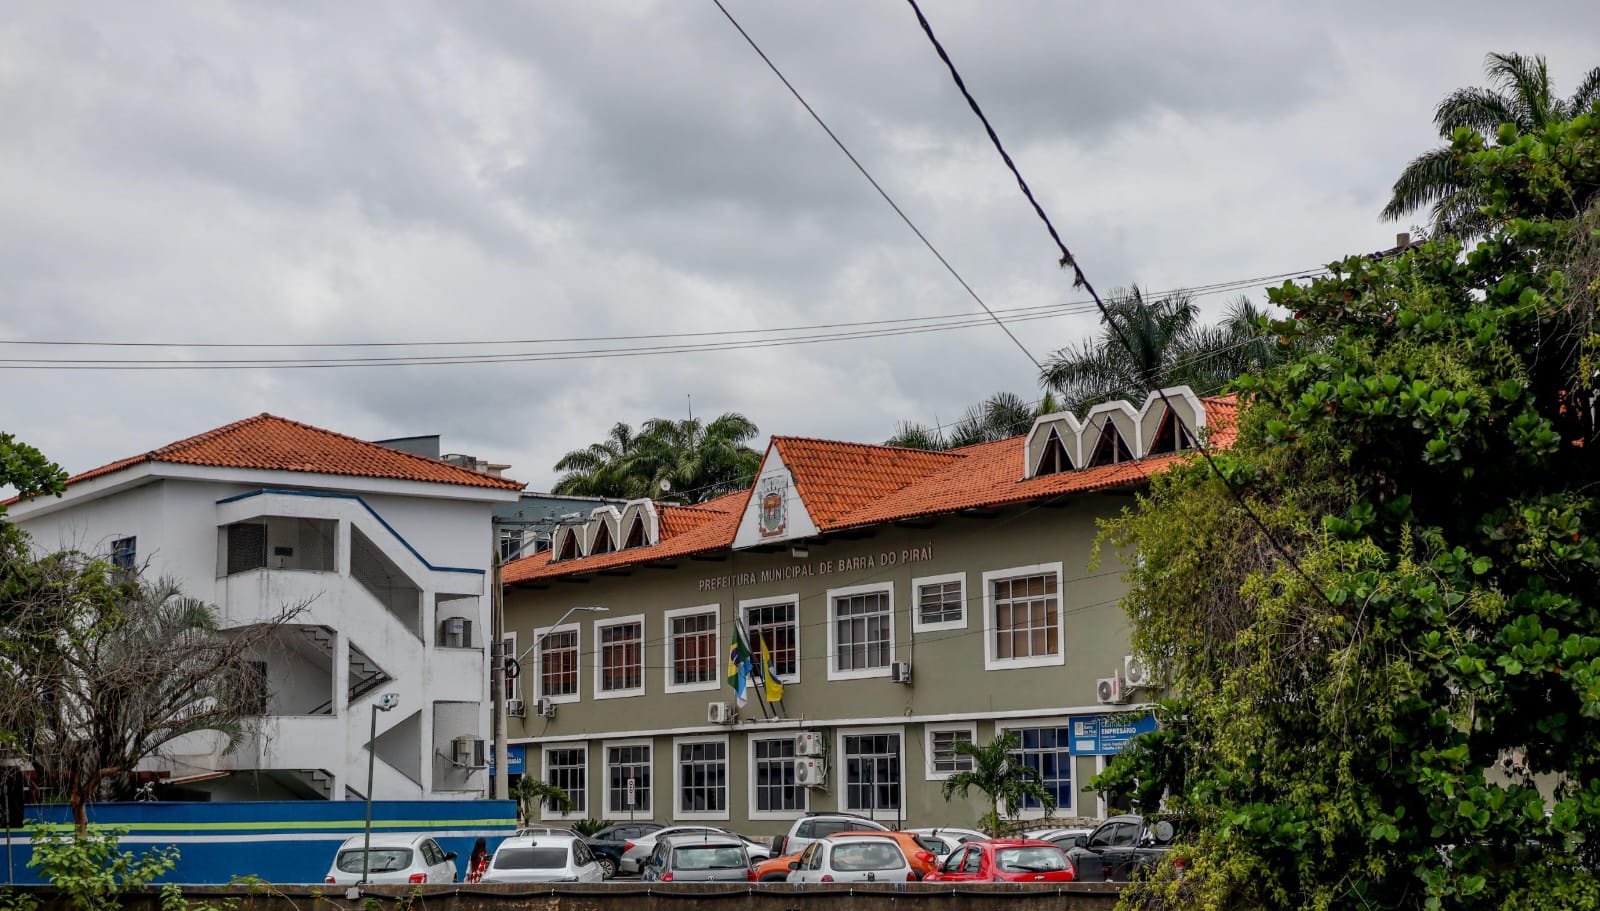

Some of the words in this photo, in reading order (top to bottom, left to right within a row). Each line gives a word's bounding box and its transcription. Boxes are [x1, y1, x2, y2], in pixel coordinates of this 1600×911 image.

[699, 572, 757, 592] PREFEITURA
[761, 562, 815, 583] MUNICIPAL
[820, 560, 834, 575] DE
[838, 554, 876, 573] BARRA
[881, 550, 898, 567] DO
[902, 541, 934, 564] PIRAÍ
